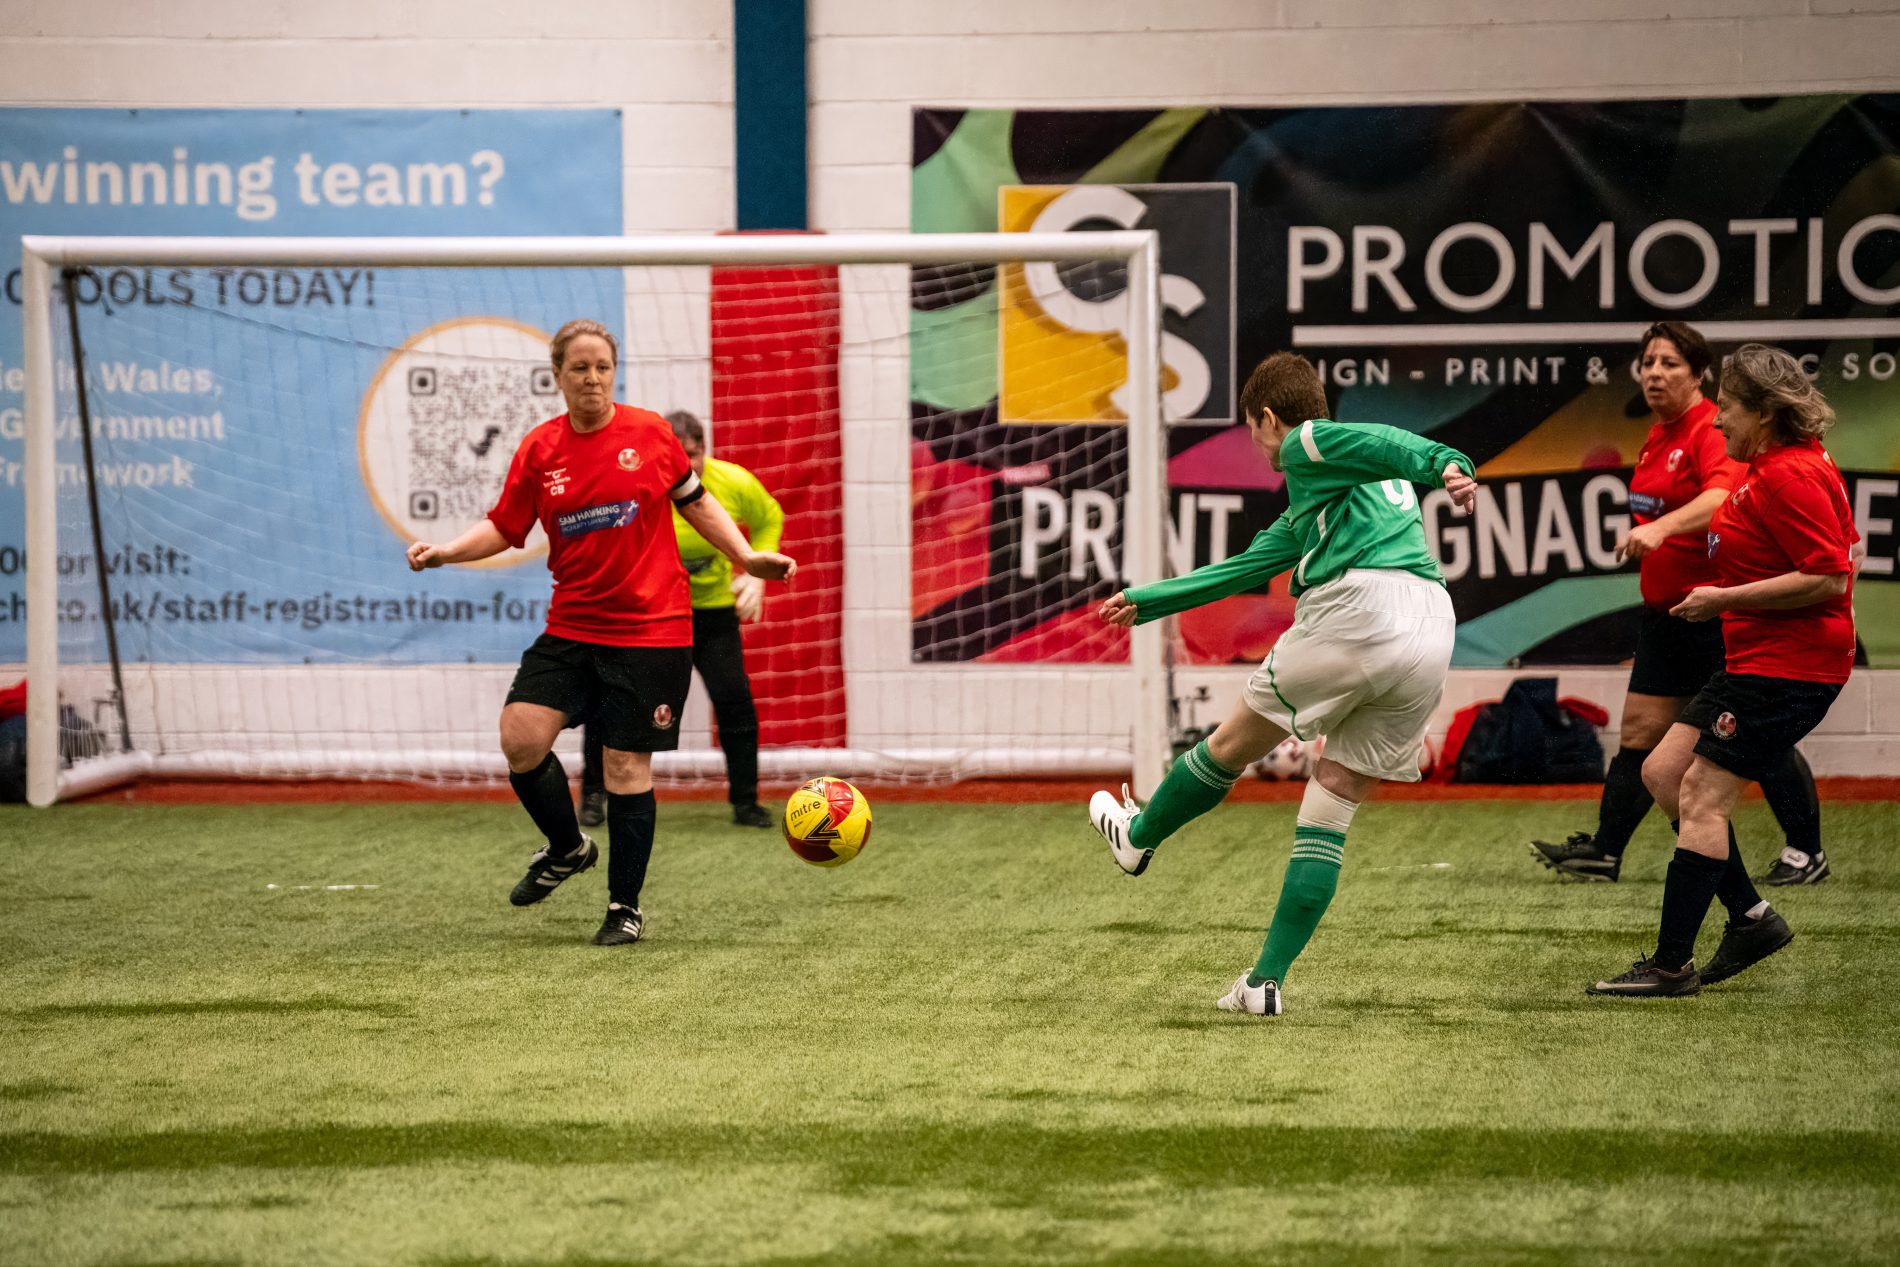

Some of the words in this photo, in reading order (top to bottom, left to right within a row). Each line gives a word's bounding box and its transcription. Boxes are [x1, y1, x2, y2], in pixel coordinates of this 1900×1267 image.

[0, 145, 278, 221] winning
[294, 149, 507, 206] team?
[1287, 212, 1900, 314] PROMOTIO
[210, 268, 375, 308] TODAY!
[101, 359, 224, 398] Wales,
[1444, 356, 1566, 387] PRINT
[1585, 356, 1609, 386] &
[550, 485, 565, 496] CB
[576, 504, 621, 521] HAWKING
[790, 800, 821, 822] mitre
